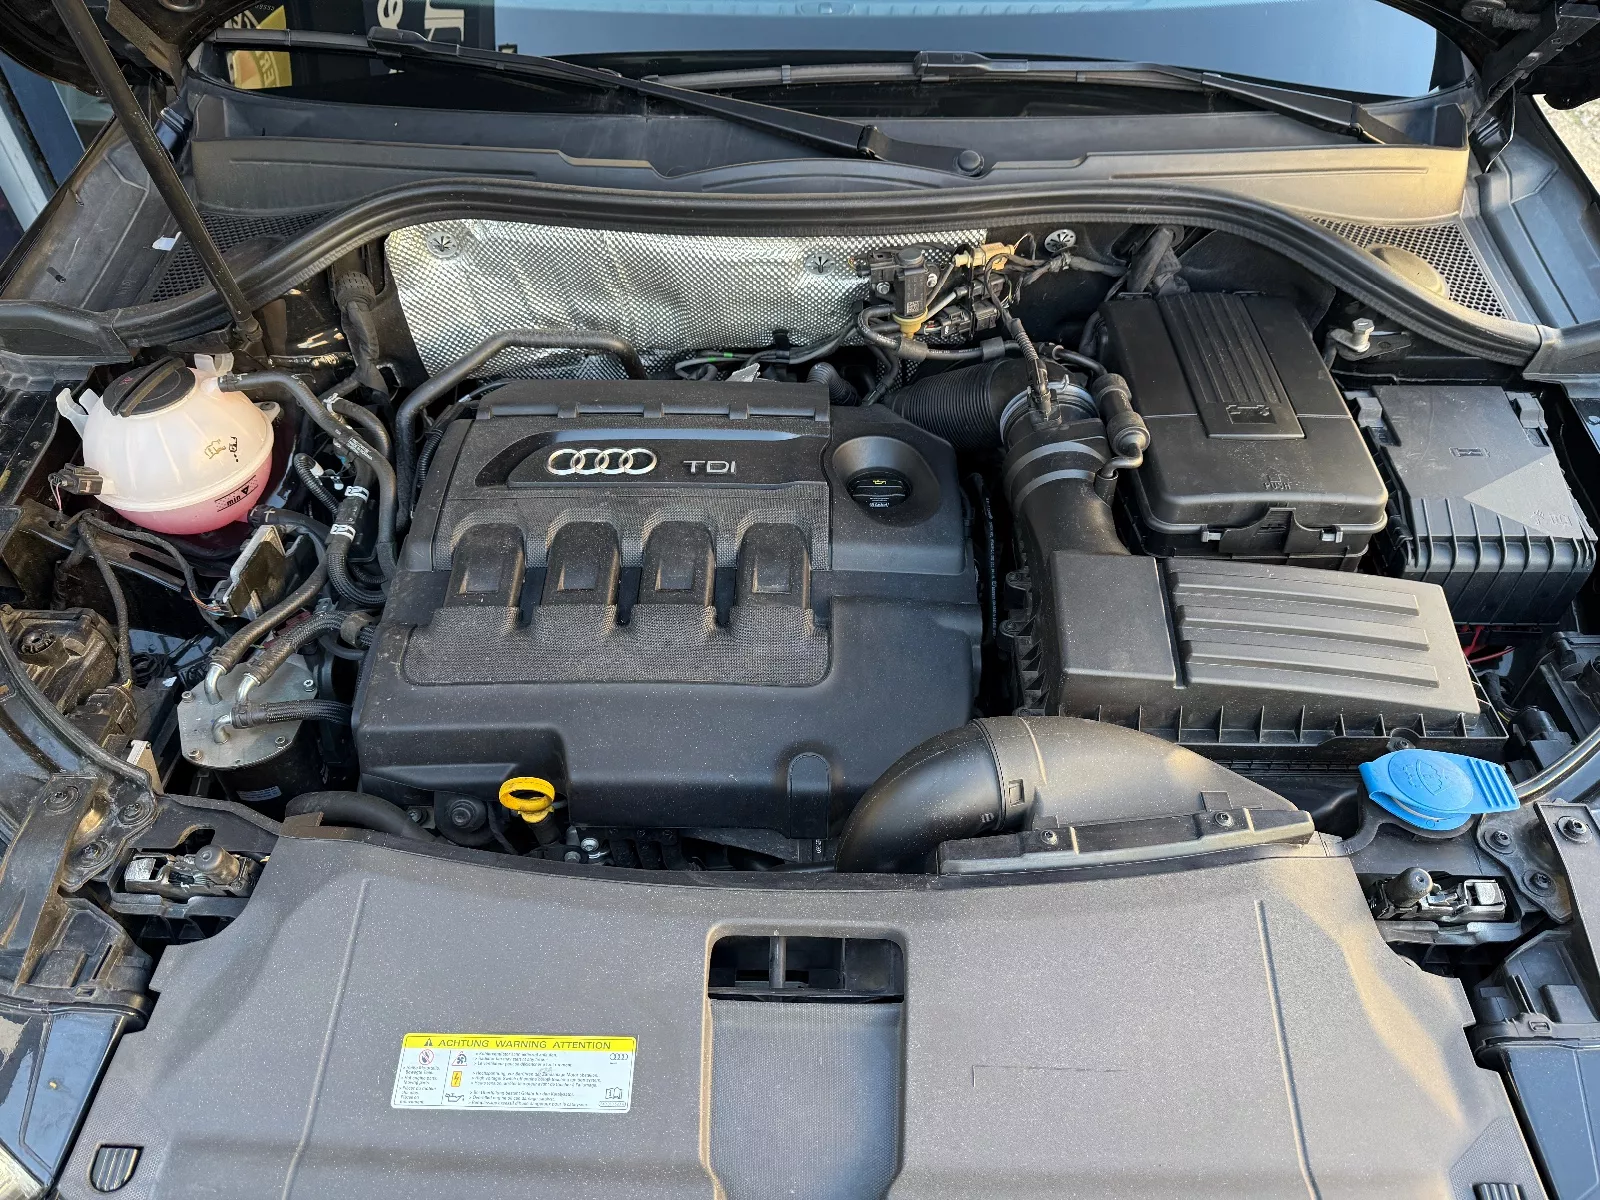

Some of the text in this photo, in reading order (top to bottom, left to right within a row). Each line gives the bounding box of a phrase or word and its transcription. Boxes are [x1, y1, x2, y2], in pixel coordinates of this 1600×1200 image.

[683, 460, 736, 474] TDI
[226, 494, 242, 507] min
[437, 1039, 611, 1050] ACHTUNG WARNING ATTENTION
